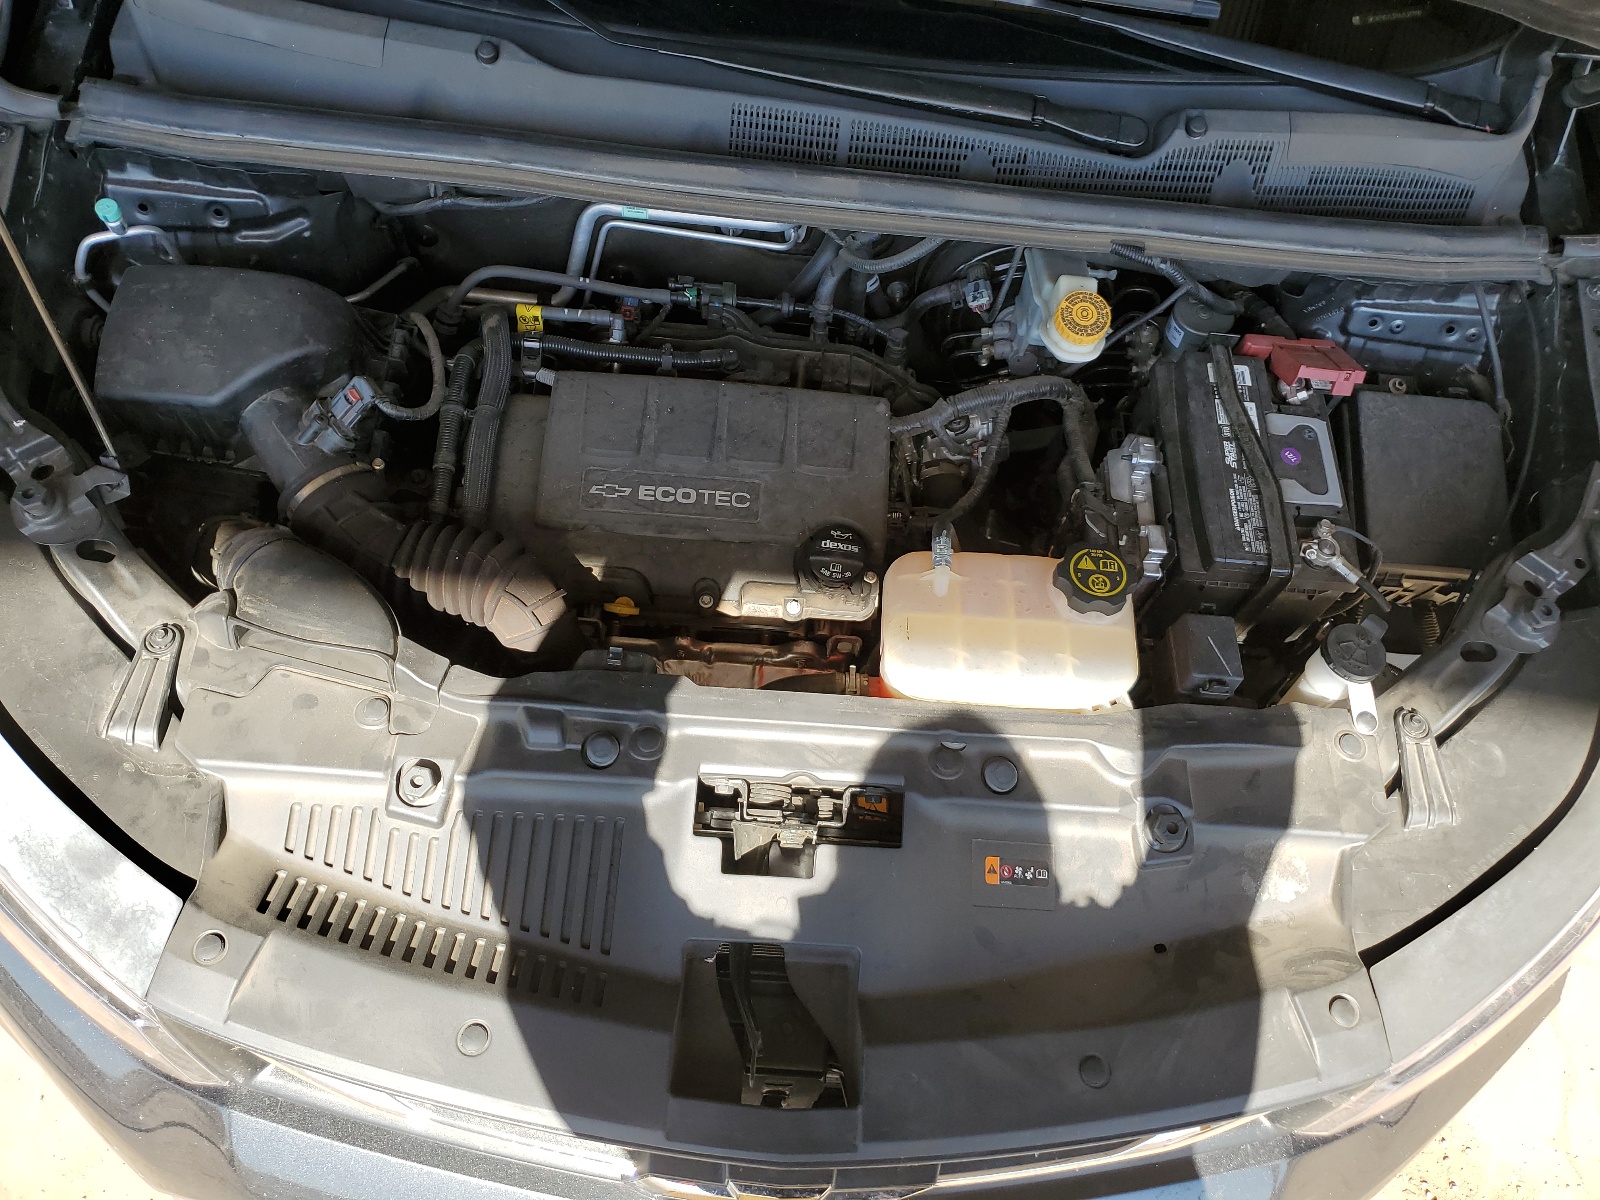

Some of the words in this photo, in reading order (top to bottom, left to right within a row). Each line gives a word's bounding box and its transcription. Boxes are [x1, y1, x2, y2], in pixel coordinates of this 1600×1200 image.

[1285, 451, 1298, 463] 7/21
[638, 485, 751, 508] ECOTEC
[821, 540, 859, 553] dexos
[820, 568, 832, 577] SAE
